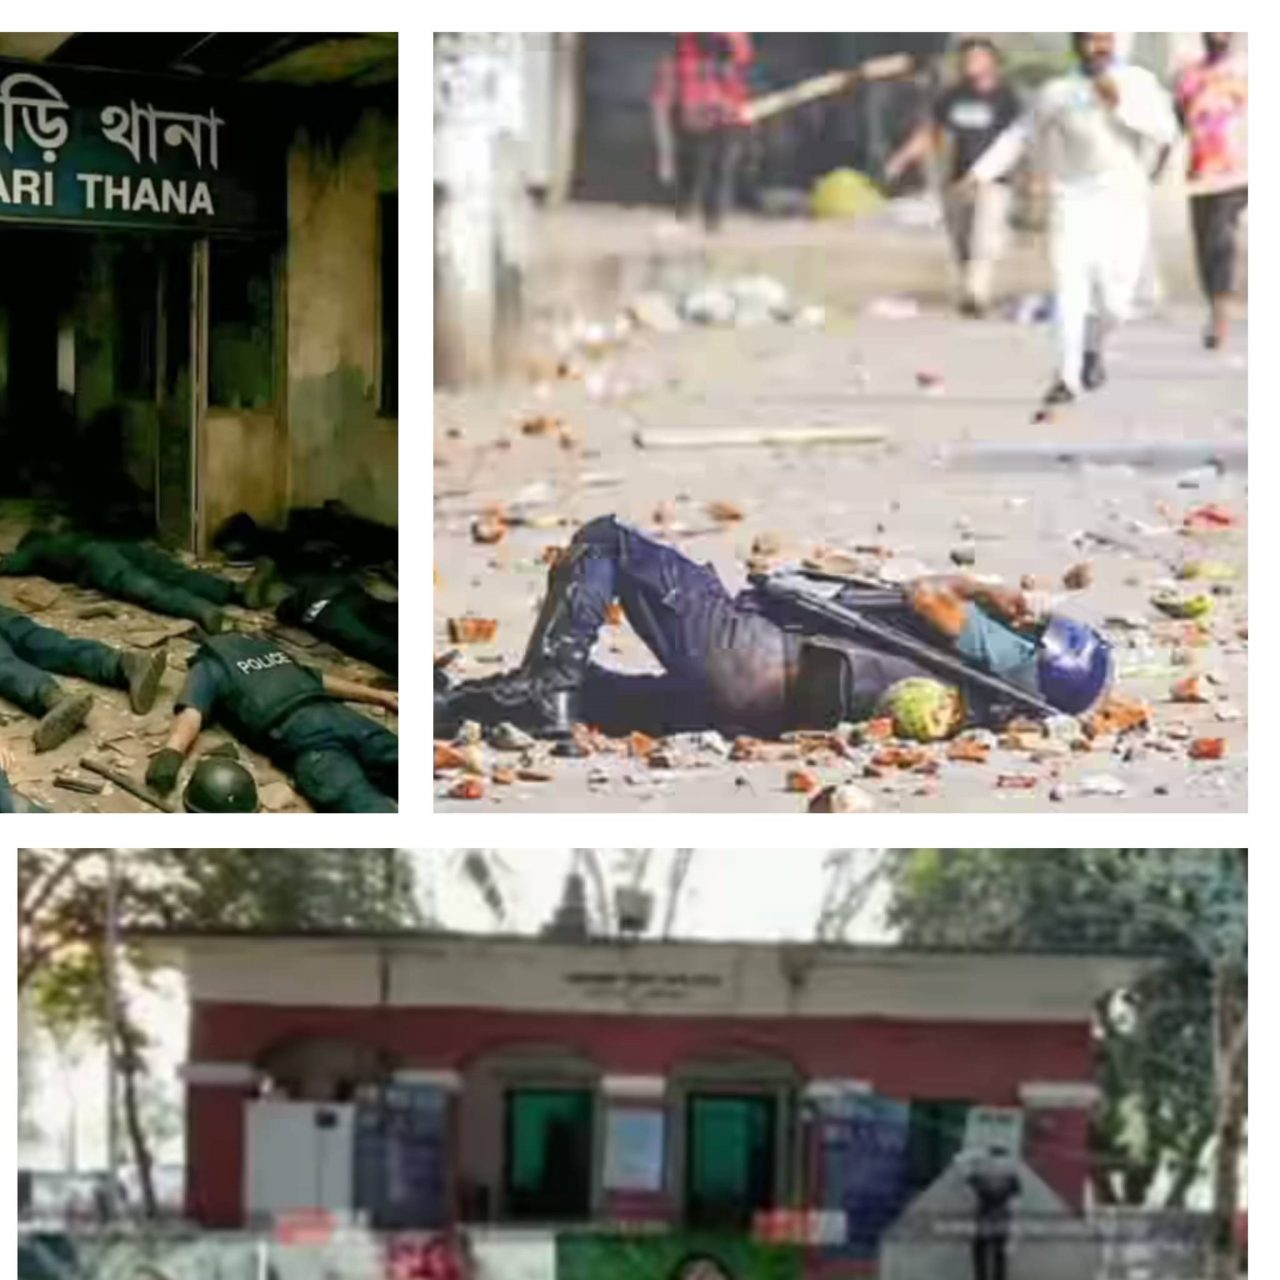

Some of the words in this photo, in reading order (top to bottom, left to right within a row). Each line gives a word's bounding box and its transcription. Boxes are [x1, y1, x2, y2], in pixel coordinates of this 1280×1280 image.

[100, 99, 226, 170] থানা
[76, 173, 215, 215] THANA
[236, 651, 292, 674] POLICE
